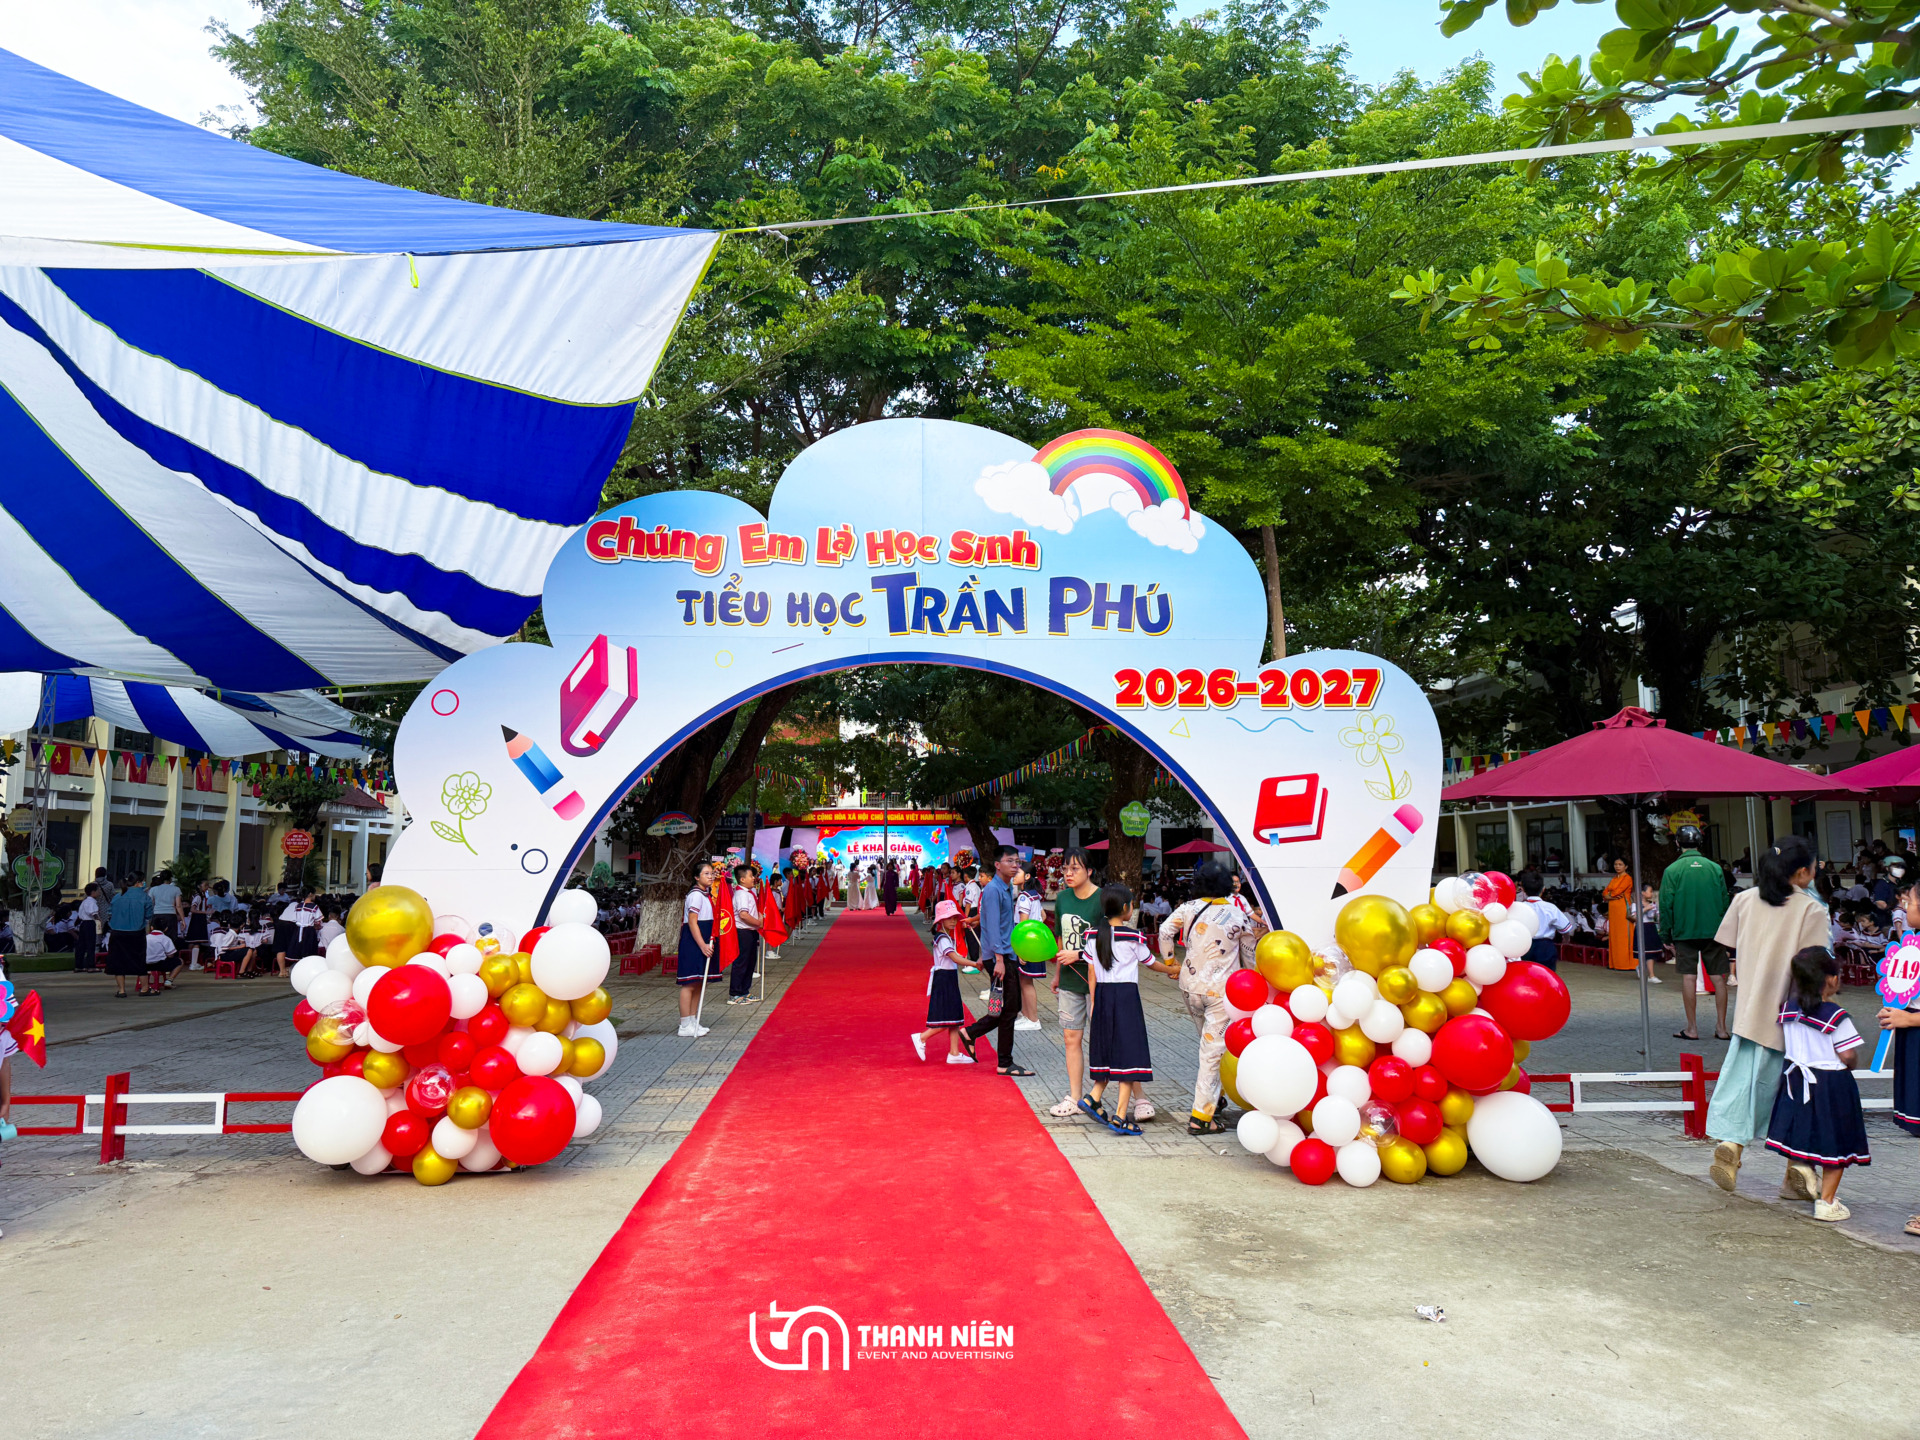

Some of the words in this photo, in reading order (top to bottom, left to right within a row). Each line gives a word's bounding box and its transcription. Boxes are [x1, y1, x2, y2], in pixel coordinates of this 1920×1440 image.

[585, 515, 725, 574] Chúng
[737, 522, 806, 564] Em
[815, 523, 857, 565] Là
[865, 528, 940, 565] Học
[948, 529, 1040, 568] Sinh
[675, 571, 772, 626] TIỂU
[786, 591, 866, 635] HỌC
[870, 571, 1028, 637] TRẦN
[1047, 575, 1174, 636] PHÚ
[1113, 667, 1382, 708] 2026-2027
[905, 812, 919, 822] VIỆT
[847, 841, 859, 853] LỄ
[862, 843, 884, 852] KHA
[890, 841, 922, 853] GIẢNG
